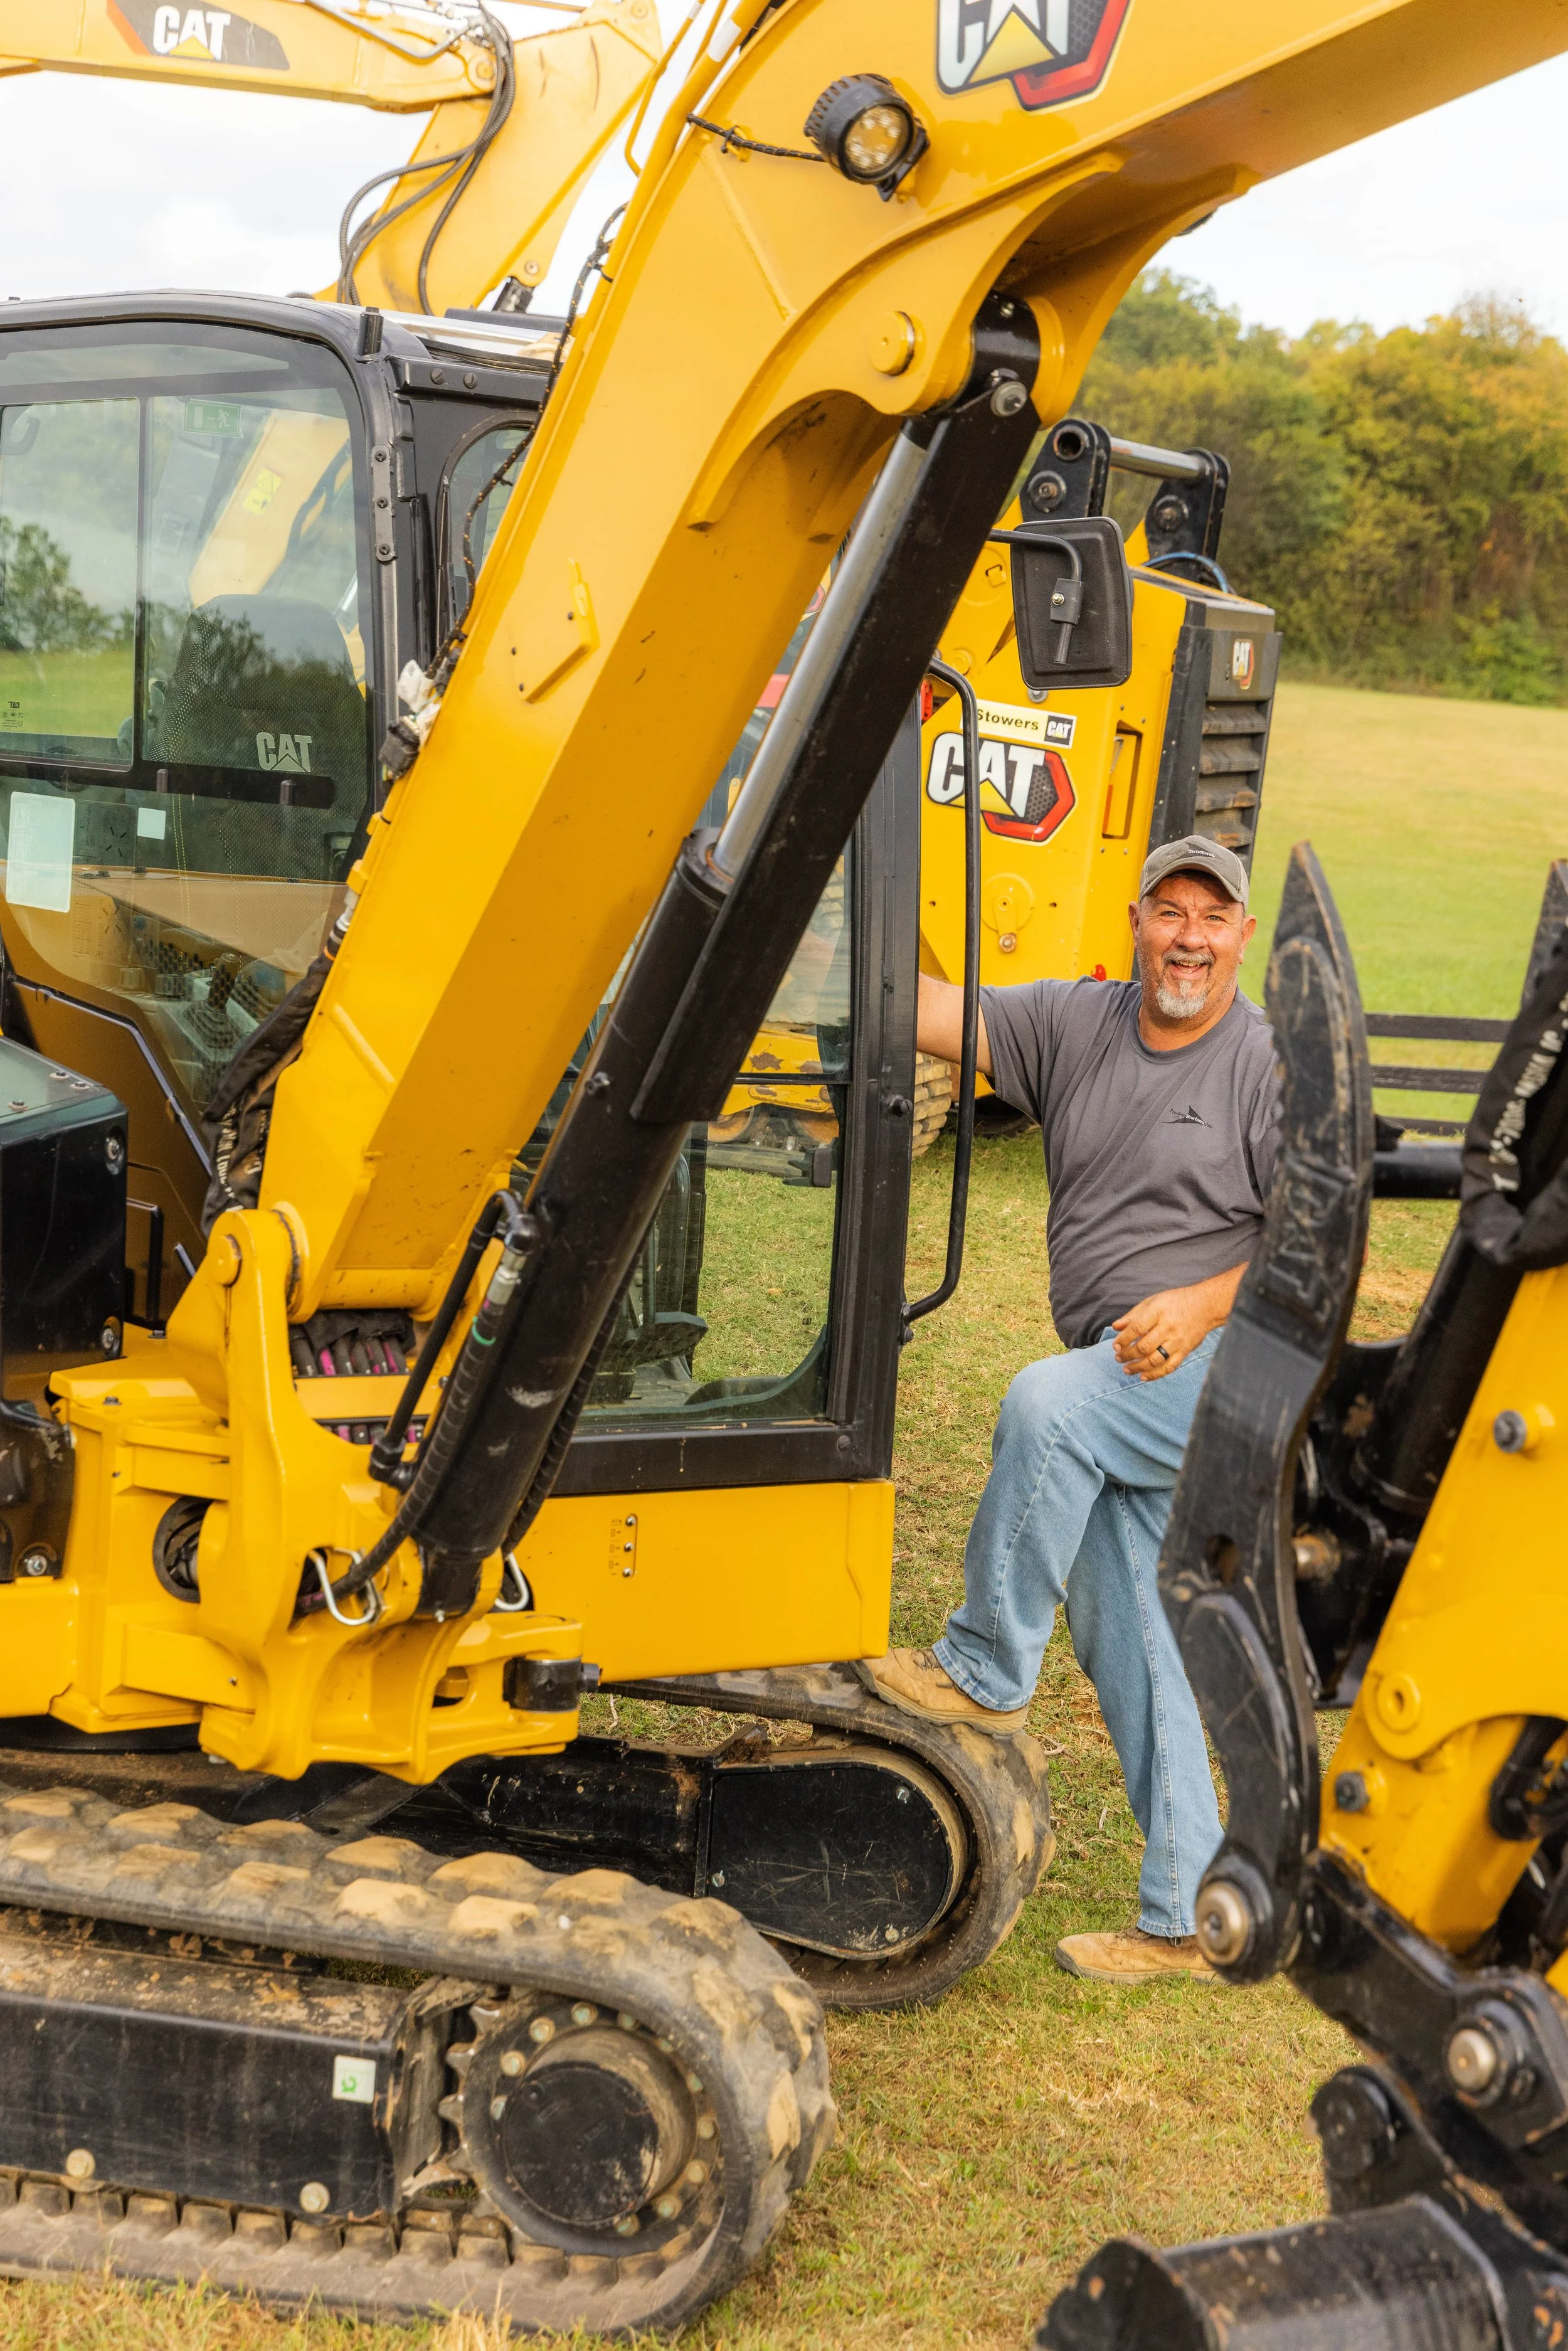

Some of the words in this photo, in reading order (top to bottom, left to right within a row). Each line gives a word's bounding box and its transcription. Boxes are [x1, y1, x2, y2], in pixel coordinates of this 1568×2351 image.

[153, 5, 231, 60] CAT
[977, 709, 1039, 730] Stowers
[1047, 721, 1071, 739] CAT
[257, 732, 312, 772] CAT
[928, 733, 1046, 817] CAT
